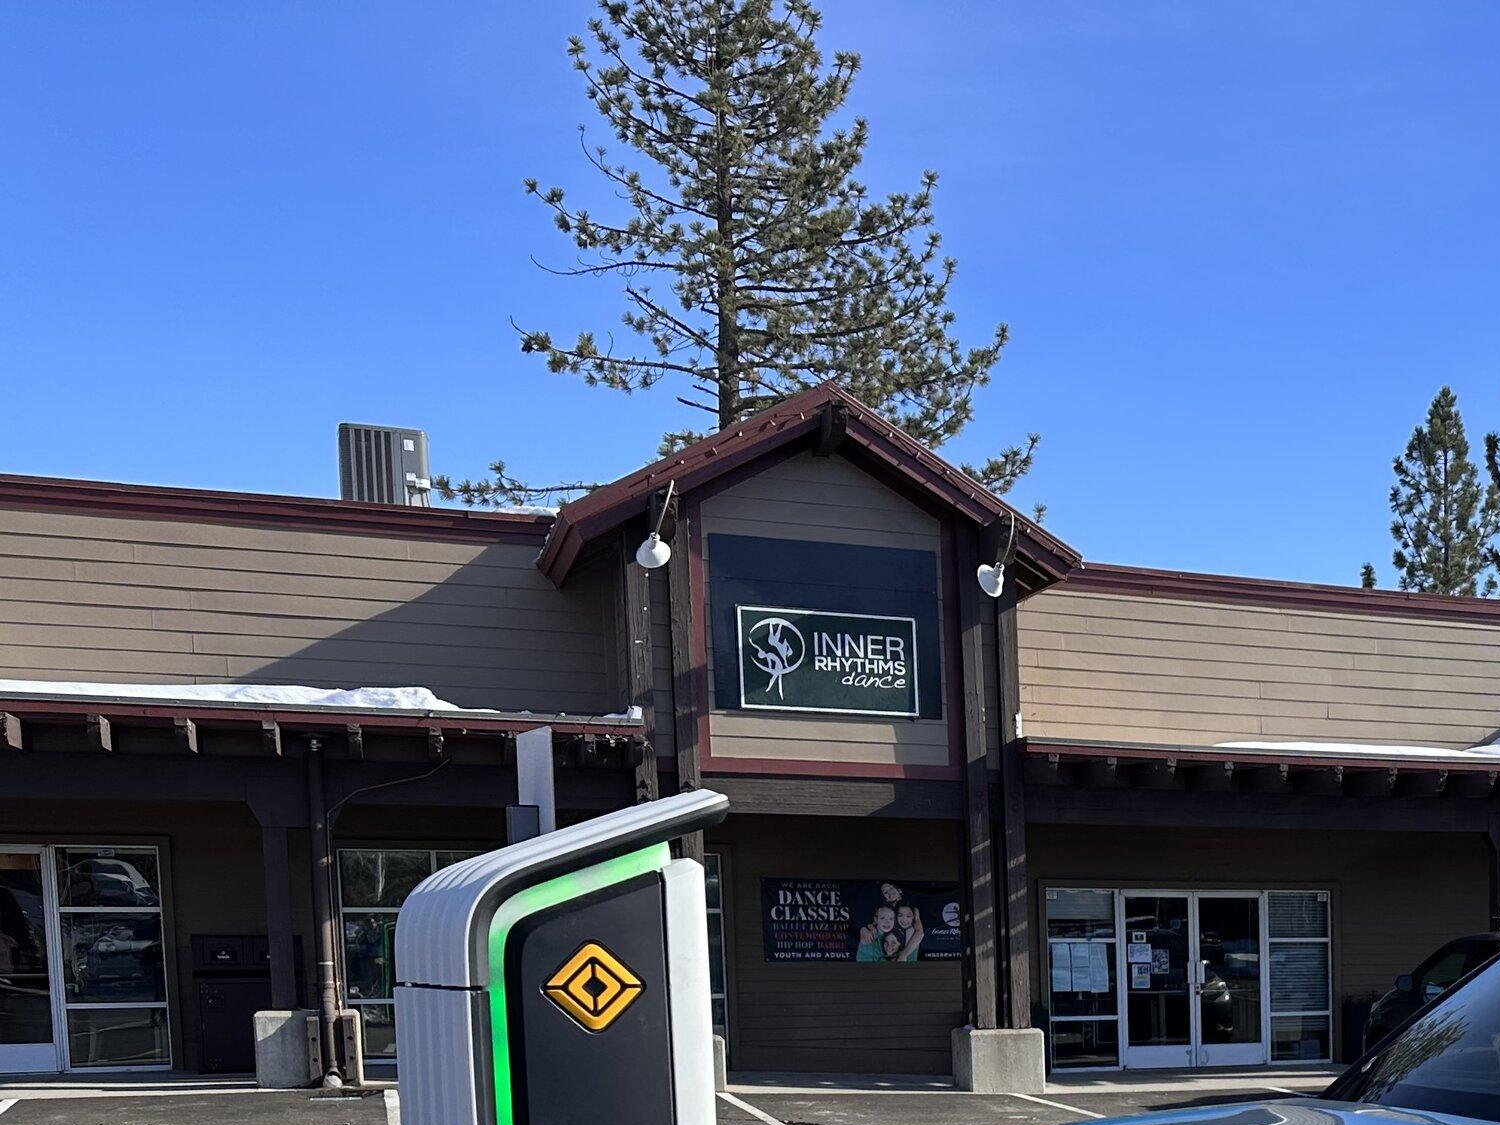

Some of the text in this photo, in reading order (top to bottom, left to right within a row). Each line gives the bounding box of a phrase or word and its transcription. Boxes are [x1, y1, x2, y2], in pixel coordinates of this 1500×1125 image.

[813, 631, 905, 661] INNER
[814, 656, 907, 676] RHYTHMS
[841, 672, 907, 689] dance
[778, 890, 842, 906] DANCE
[770, 906, 850, 922] CLASSES
[773, 922, 807, 931] BALLET
[809, 922, 829, 931] JAZZ
[795, 941, 814, 950] HOP
